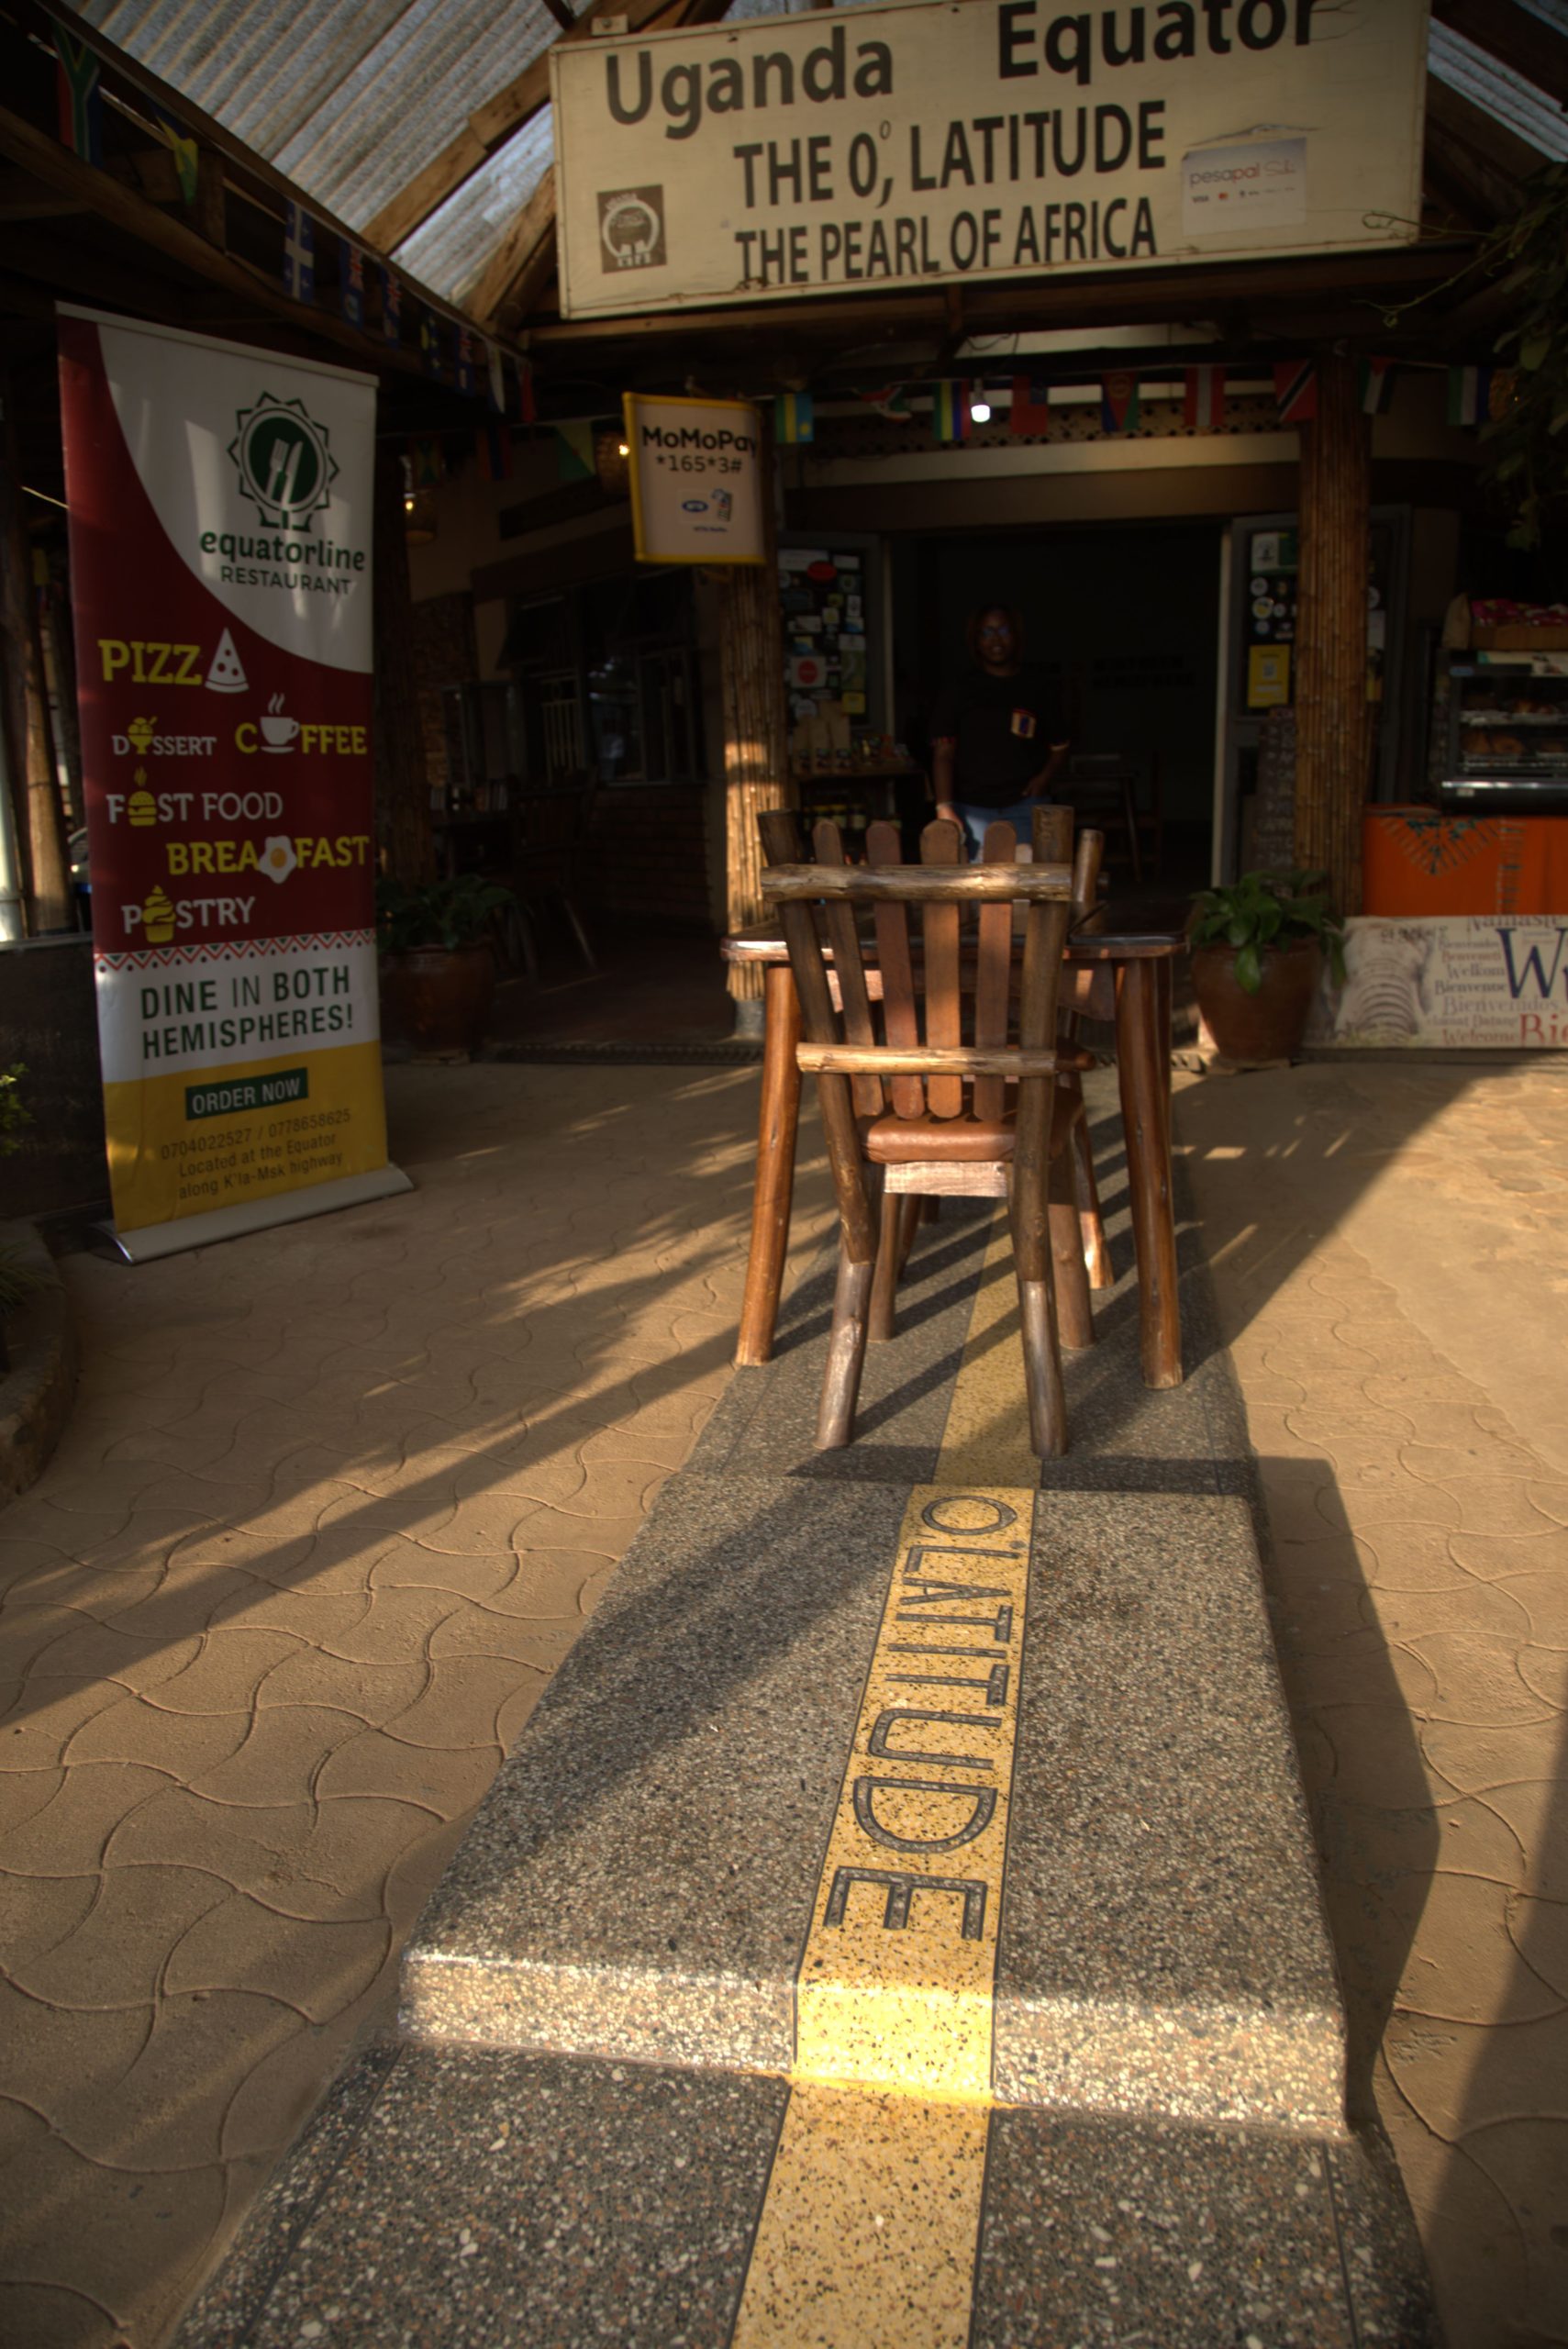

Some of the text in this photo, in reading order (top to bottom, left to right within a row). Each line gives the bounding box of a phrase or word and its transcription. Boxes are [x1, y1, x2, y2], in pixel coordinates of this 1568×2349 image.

[606, 0, 1314, 140] Uganda Equator
[733, 136, 834, 208] THE
[910, 100, 1166, 192] LATITUDE
[1189, 162, 1261, 188] pesapal
[735, 196, 1157, 284] THE PEARL OF AFRICA
[642, 426, 756, 458] MoMoPay
[200, 530, 365, 571] equatorline
[220, 565, 352, 595] RESTAURANT
[105, 791, 284, 824] FST FOOD
[165, 835, 371, 875] BREAFAST
[120, 896, 256, 935] PSTRY
[141, 964, 350, 1020] DINE IN BOTH
[142, 1003, 353, 1059] HEMISPHERES!
[192, 1076, 301, 1115] ORDER NOW
[161, 1128, 252, 1160] 0704022527
[179, 1132, 337, 1177] Located at the Equator
[178, 1181, 219, 1199] along
[290, 1151, 344, 1175] highway
[824, 1545, 1020, 1942] LATITUDE
